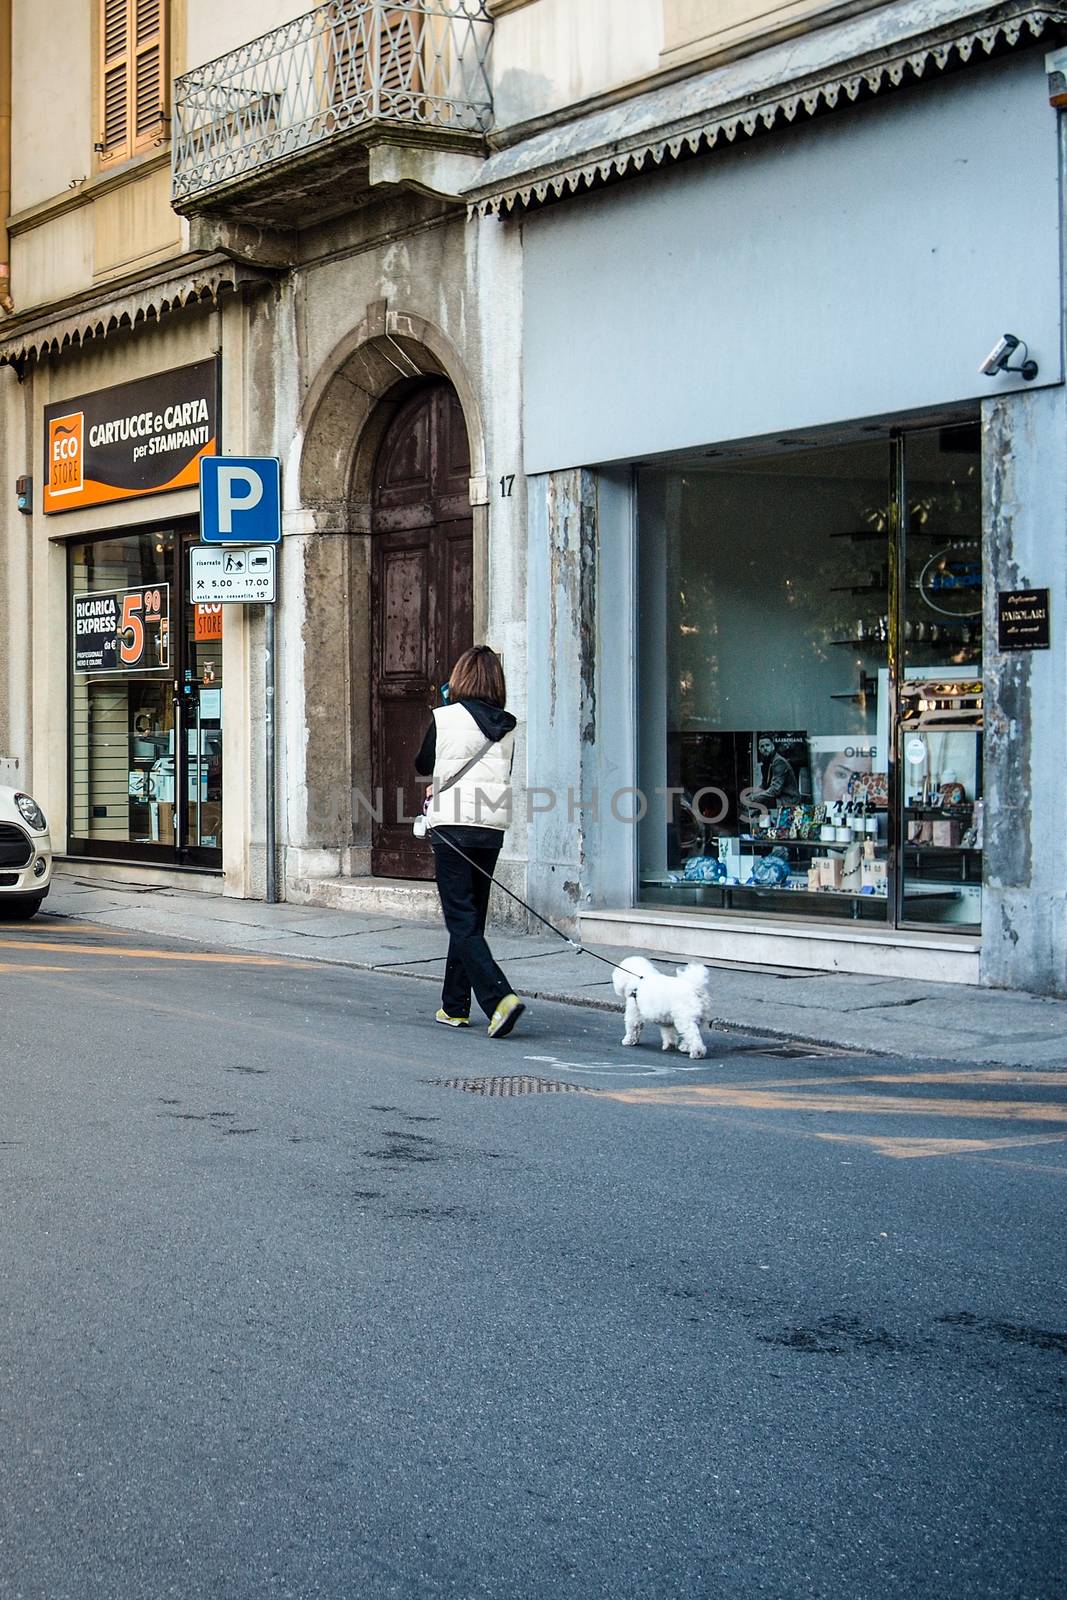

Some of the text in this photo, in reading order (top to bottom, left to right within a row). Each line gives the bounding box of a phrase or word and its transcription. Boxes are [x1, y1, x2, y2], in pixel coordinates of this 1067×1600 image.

[89, 399, 209, 448] CARTUCCE e CARTA
[53, 436, 79, 461] ECO
[133, 425, 209, 462] per STAMPANTI
[53, 461, 78, 486] STORE
[500, 474, 515, 497] 17
[217, 466, 264, 533] P
[76, 599, 116, 617] RICARICA
[76, 616, 116, 635] EXPRESS
[120, 590, 160, 663] 5 90
[199, 616, 221, 634] STORE
